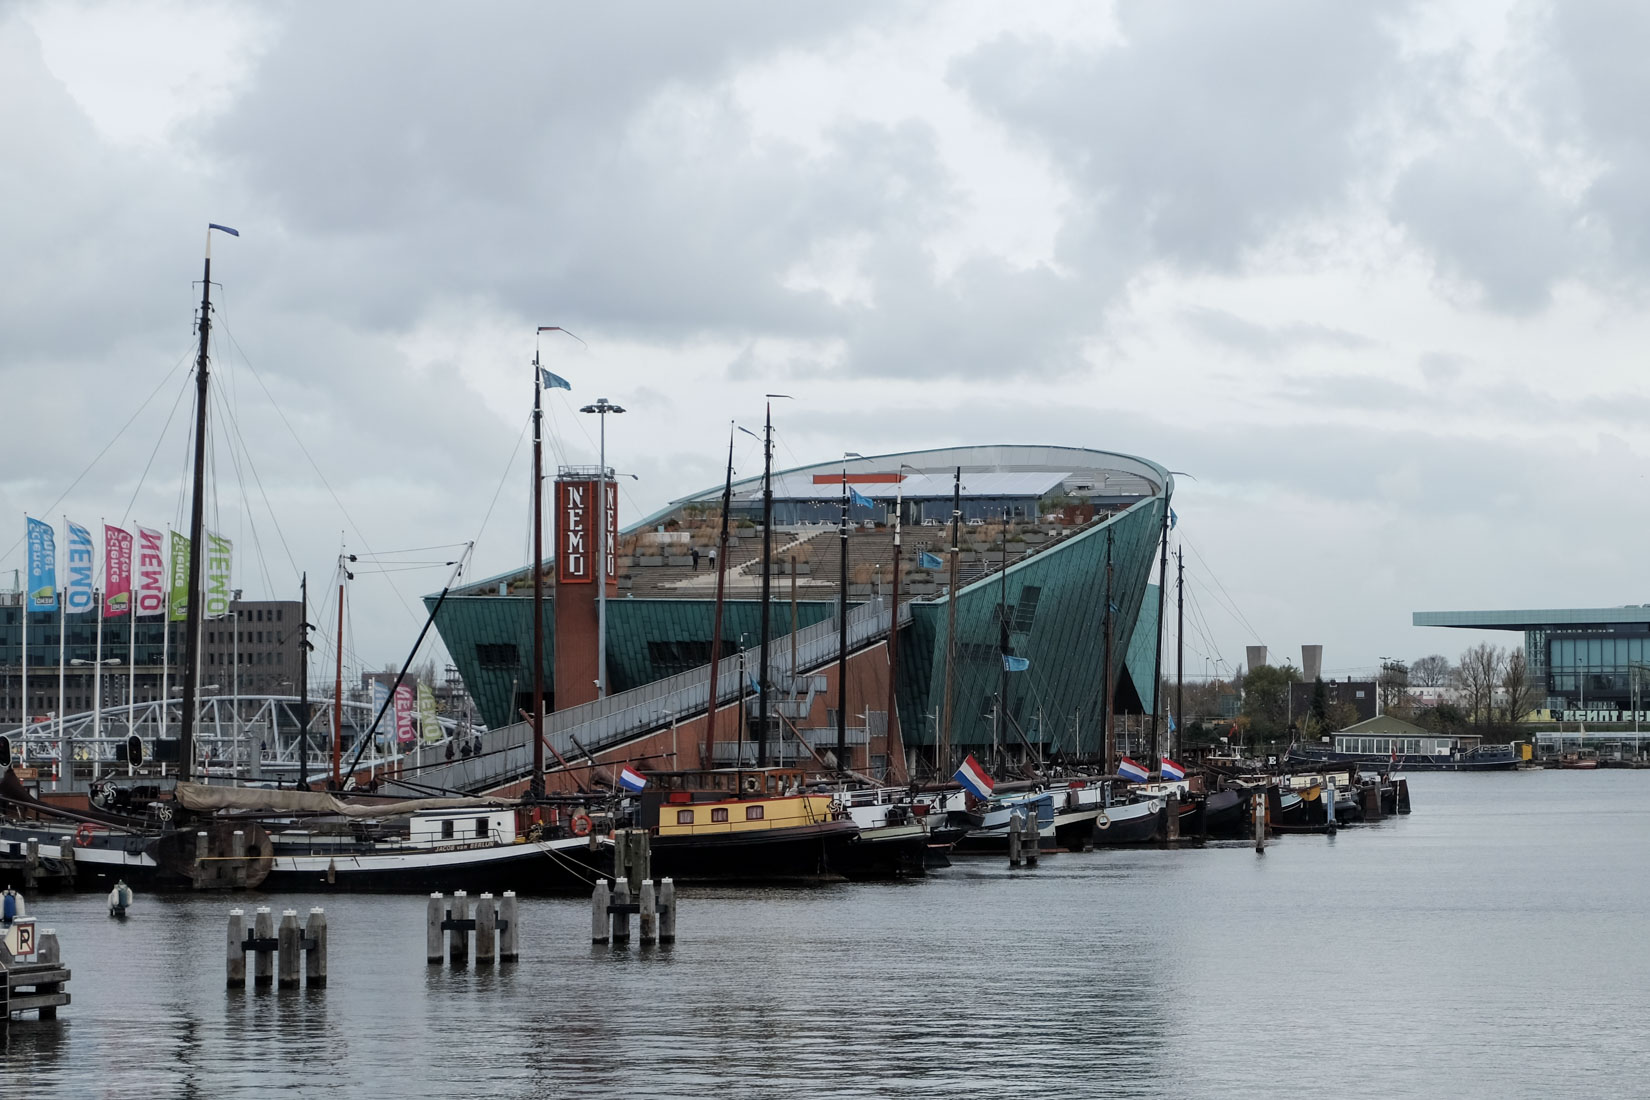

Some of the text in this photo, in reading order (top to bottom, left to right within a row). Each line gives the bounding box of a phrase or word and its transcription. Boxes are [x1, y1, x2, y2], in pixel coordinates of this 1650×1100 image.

[567, 486, 584, 576] NEMO
[606, 487, 615, 576] NEMO
[435, 844, 455, 853] JACOB
[19, 928, 30, 950] P
